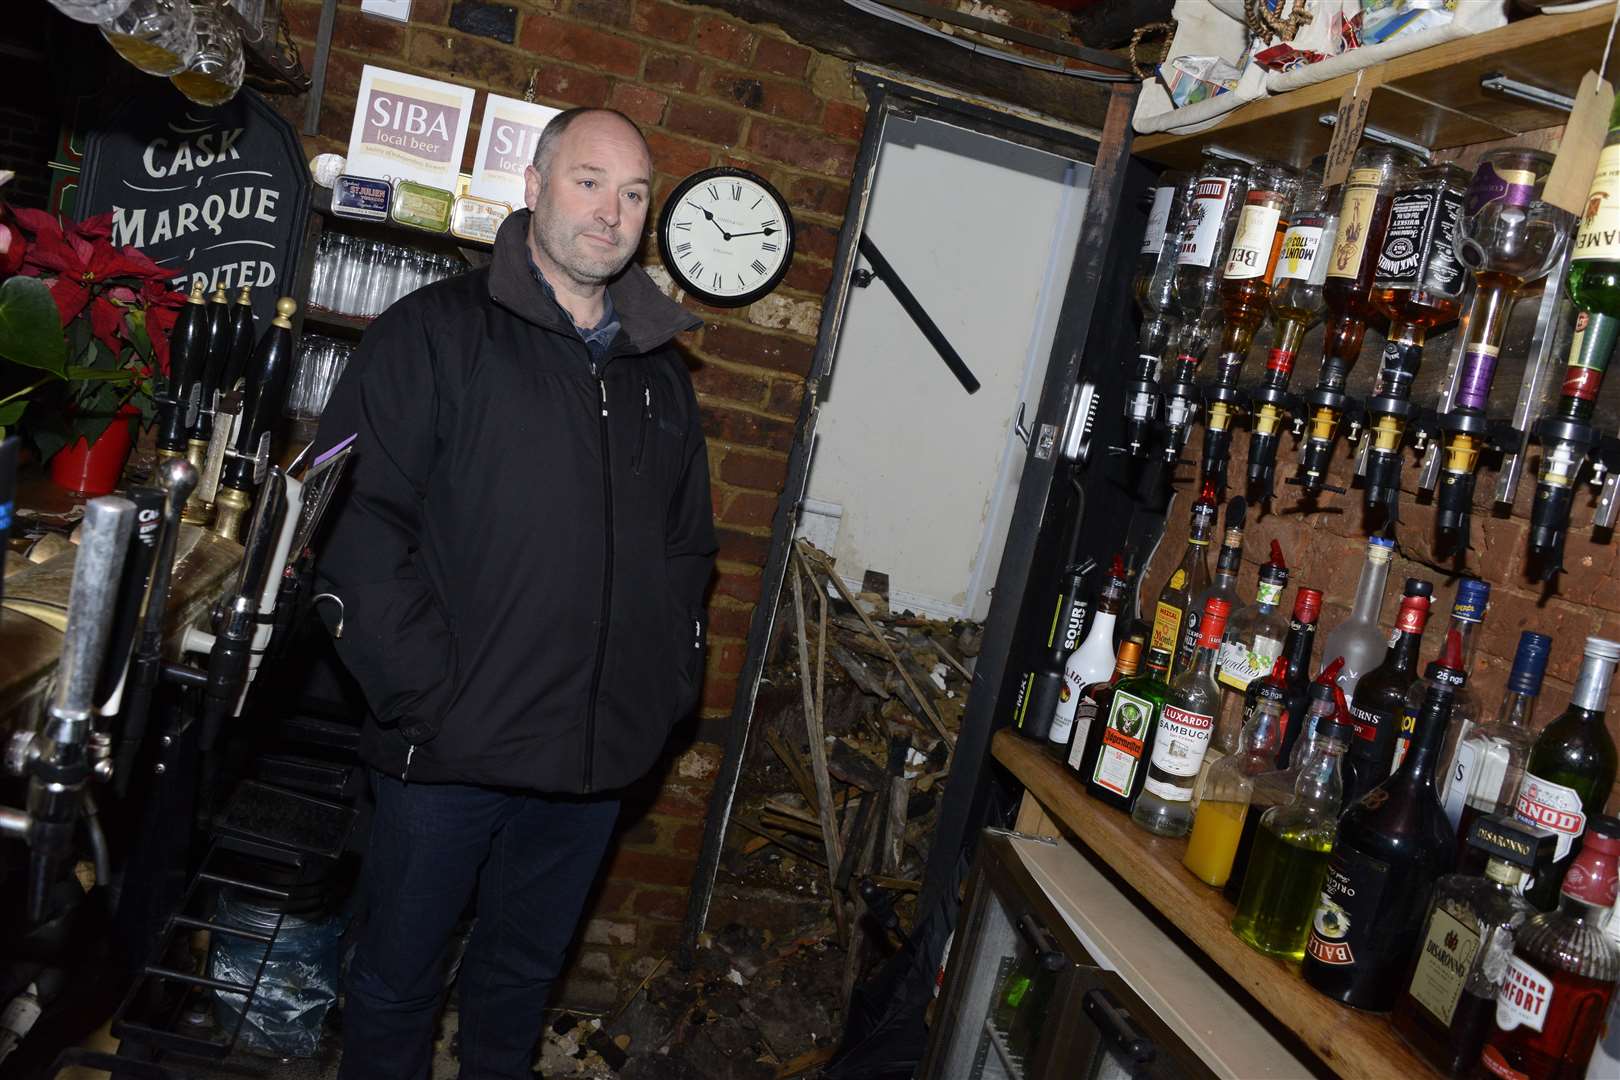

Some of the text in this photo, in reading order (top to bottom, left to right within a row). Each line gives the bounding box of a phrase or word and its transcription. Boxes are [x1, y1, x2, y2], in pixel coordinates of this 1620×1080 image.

[371, 97, 449, 142] SIBA
[142, 127, 244, 178] CASK
[376, 129, 440, 154] local beer
[111, 187, 280, 248] MARQUE
[1576, 230, 1620, 249] AME
[1284, 247, 1314, 261] MOUNT
[1064, 607, 1085, 650] SOUR
[1436, 670, 1449, 681] 25
[1260, 687, 1271, 698] 25
[1159, 718, 1210, 741] SAMBUCA
[1165, 707, 1210, 729] LUXARDO
[1477, 826, 1530, 856] DISARONNO
[1426, 938, 1466, 980] DISARONNO
